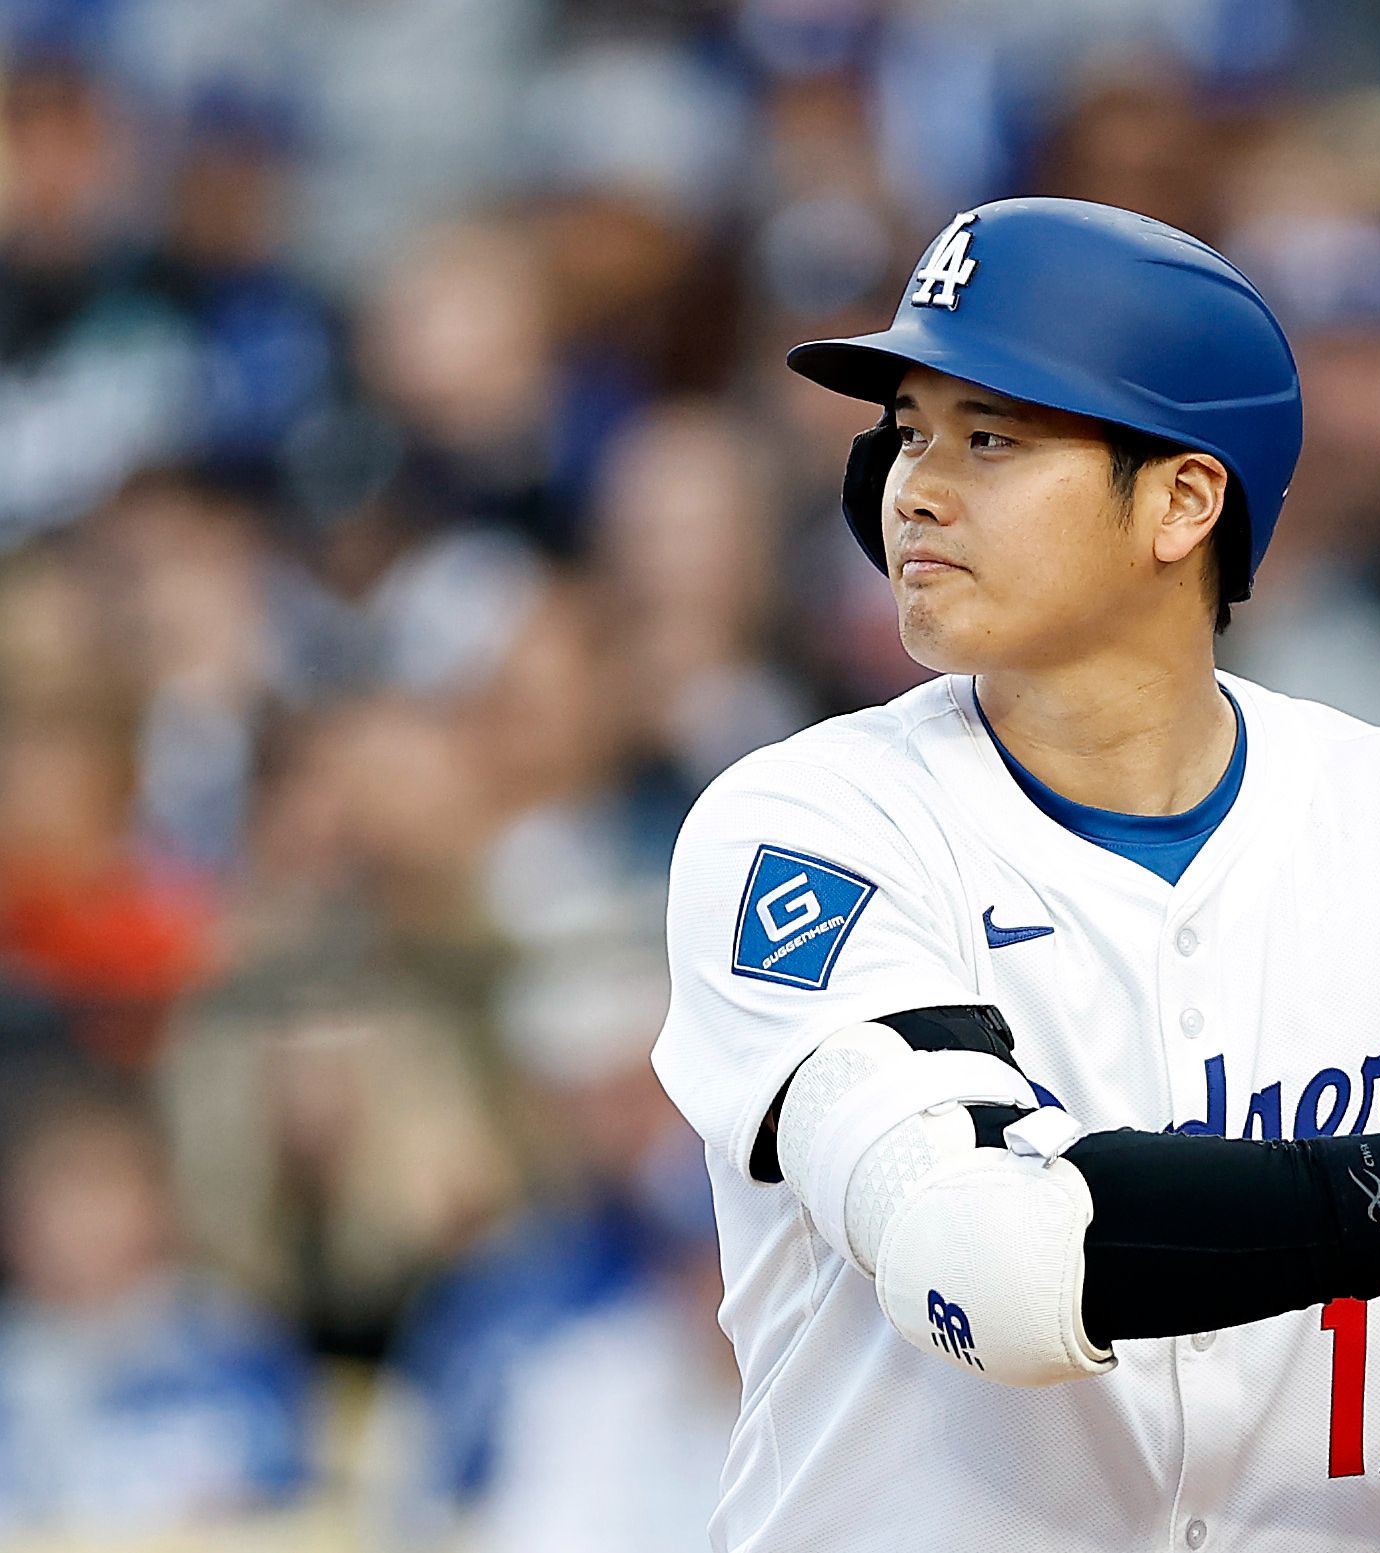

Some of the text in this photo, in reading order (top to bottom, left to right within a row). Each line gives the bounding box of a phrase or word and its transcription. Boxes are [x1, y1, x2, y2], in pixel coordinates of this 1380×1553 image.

[911, 212, 977, 306] LA
[756, 871, 821, 942] G
[762, 915, 845, 969] GUGGENHEIM
